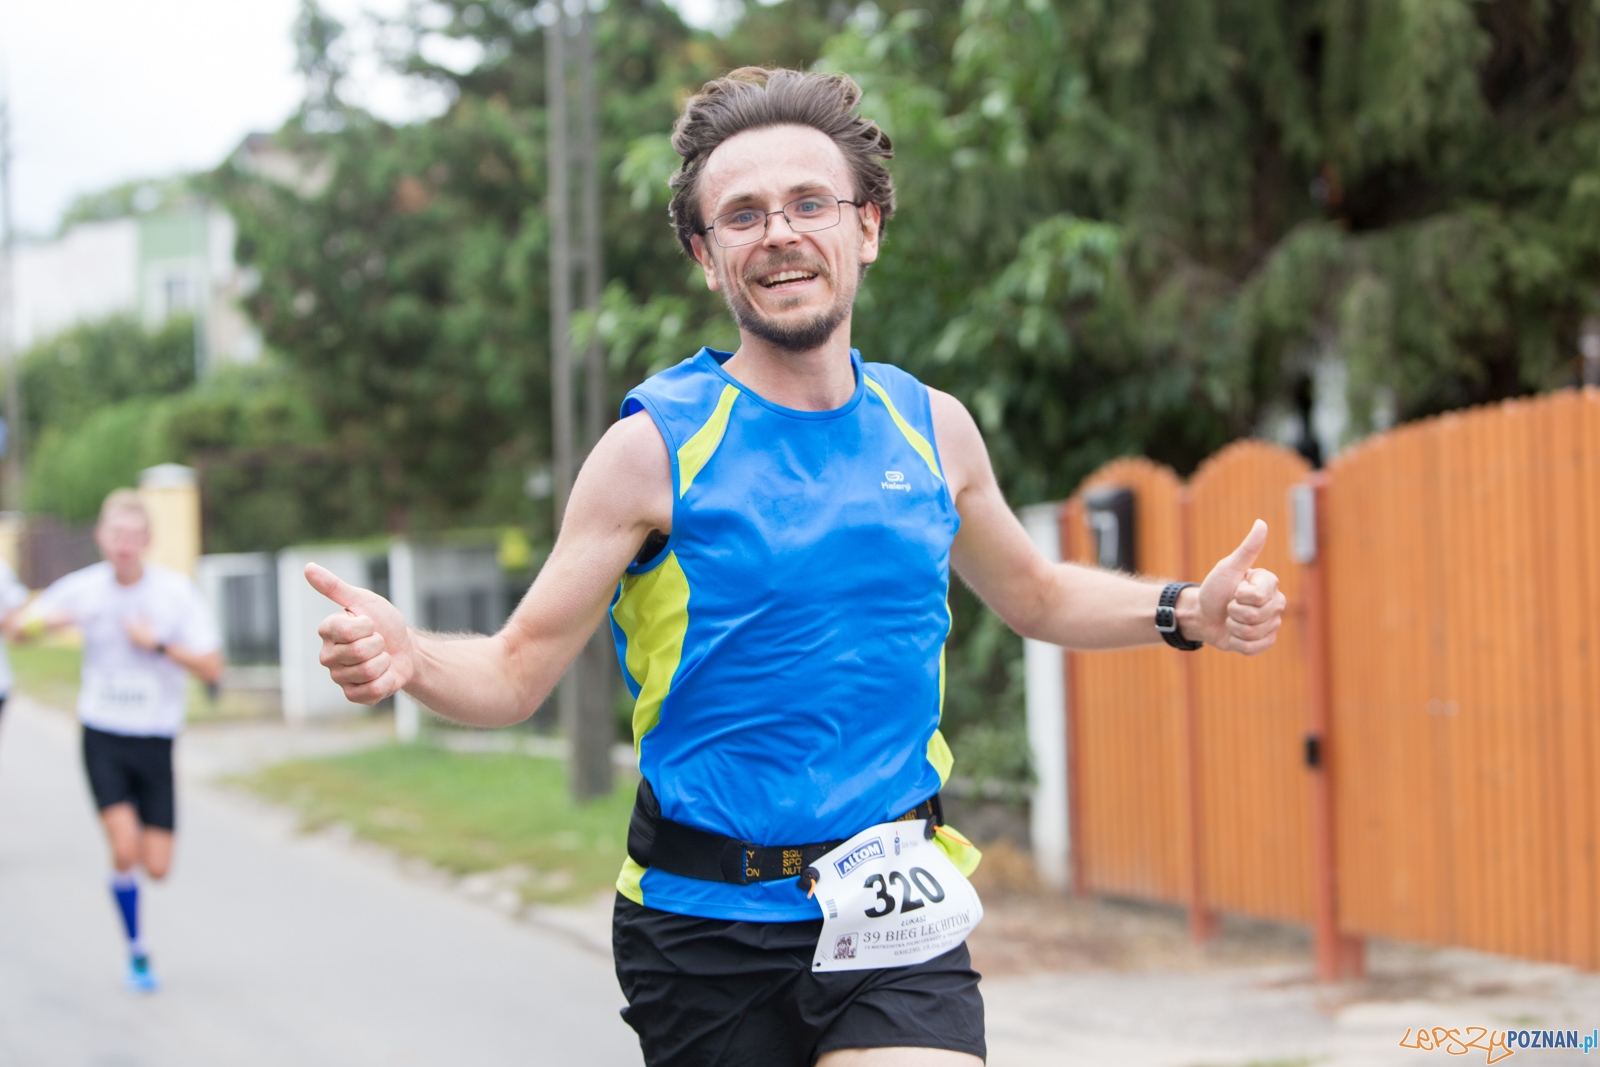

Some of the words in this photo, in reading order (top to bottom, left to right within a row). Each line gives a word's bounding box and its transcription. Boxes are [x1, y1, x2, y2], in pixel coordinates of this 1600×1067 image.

[863, 866, 945, 918] 320
[863, 931, 881, 944] 39
[885, 927, 917, 942] BIEG
[921, 909, 970, 936] LECHITÓW
